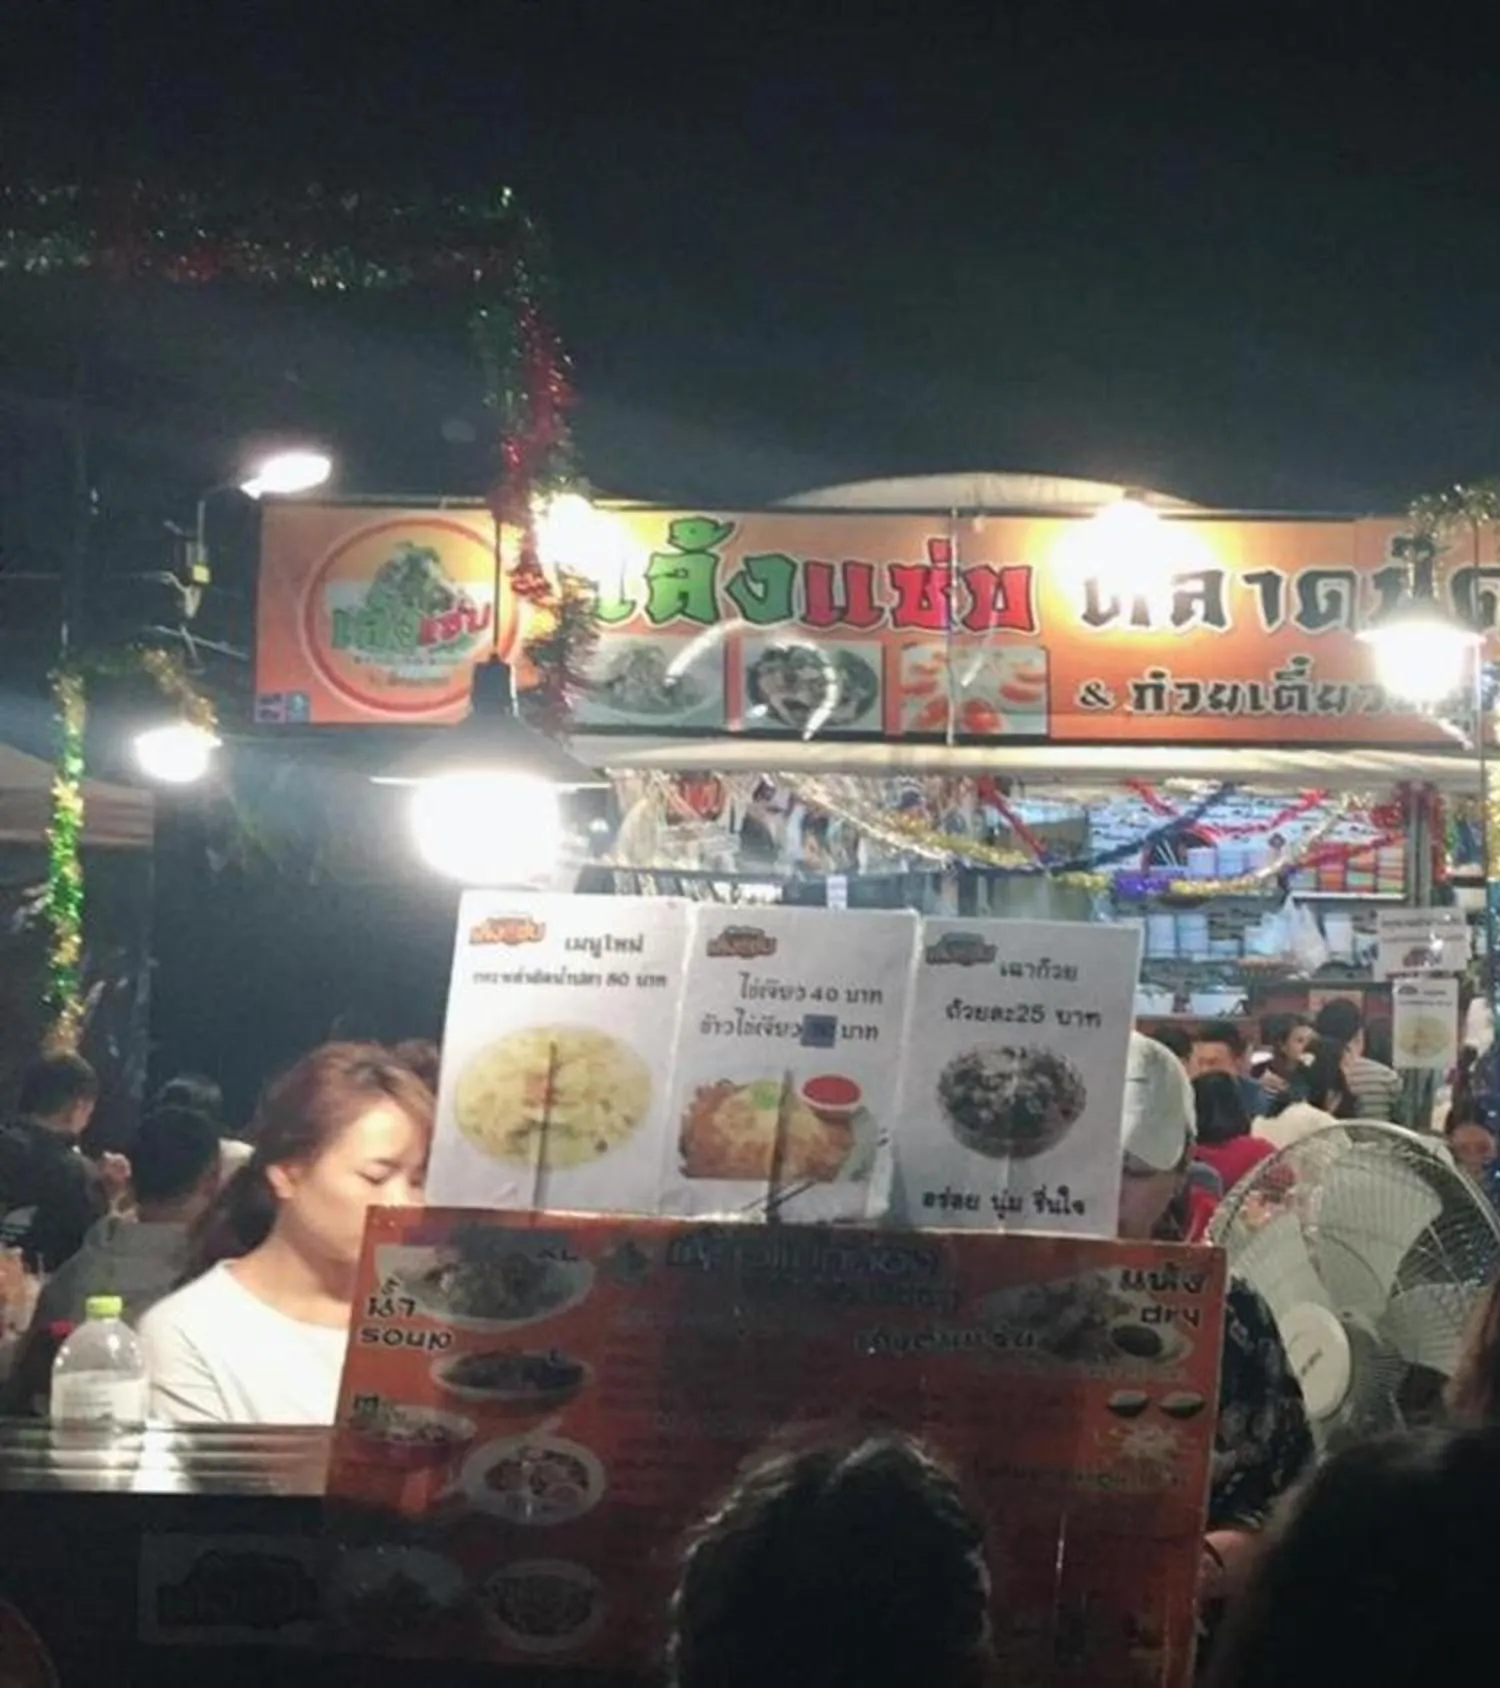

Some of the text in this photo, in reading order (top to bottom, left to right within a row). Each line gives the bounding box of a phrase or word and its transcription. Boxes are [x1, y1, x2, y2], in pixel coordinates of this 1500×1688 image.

[1080, 682, 1111, 707] &
[565, 934, 644, 958] เมนูใหม่
[636, 973, 667, 988] บาท
[844, 988, 883, 1005] บาท
[1056, 1008, 1101, 1028] บาท
[841, 1024, 879, 1041] บาท
